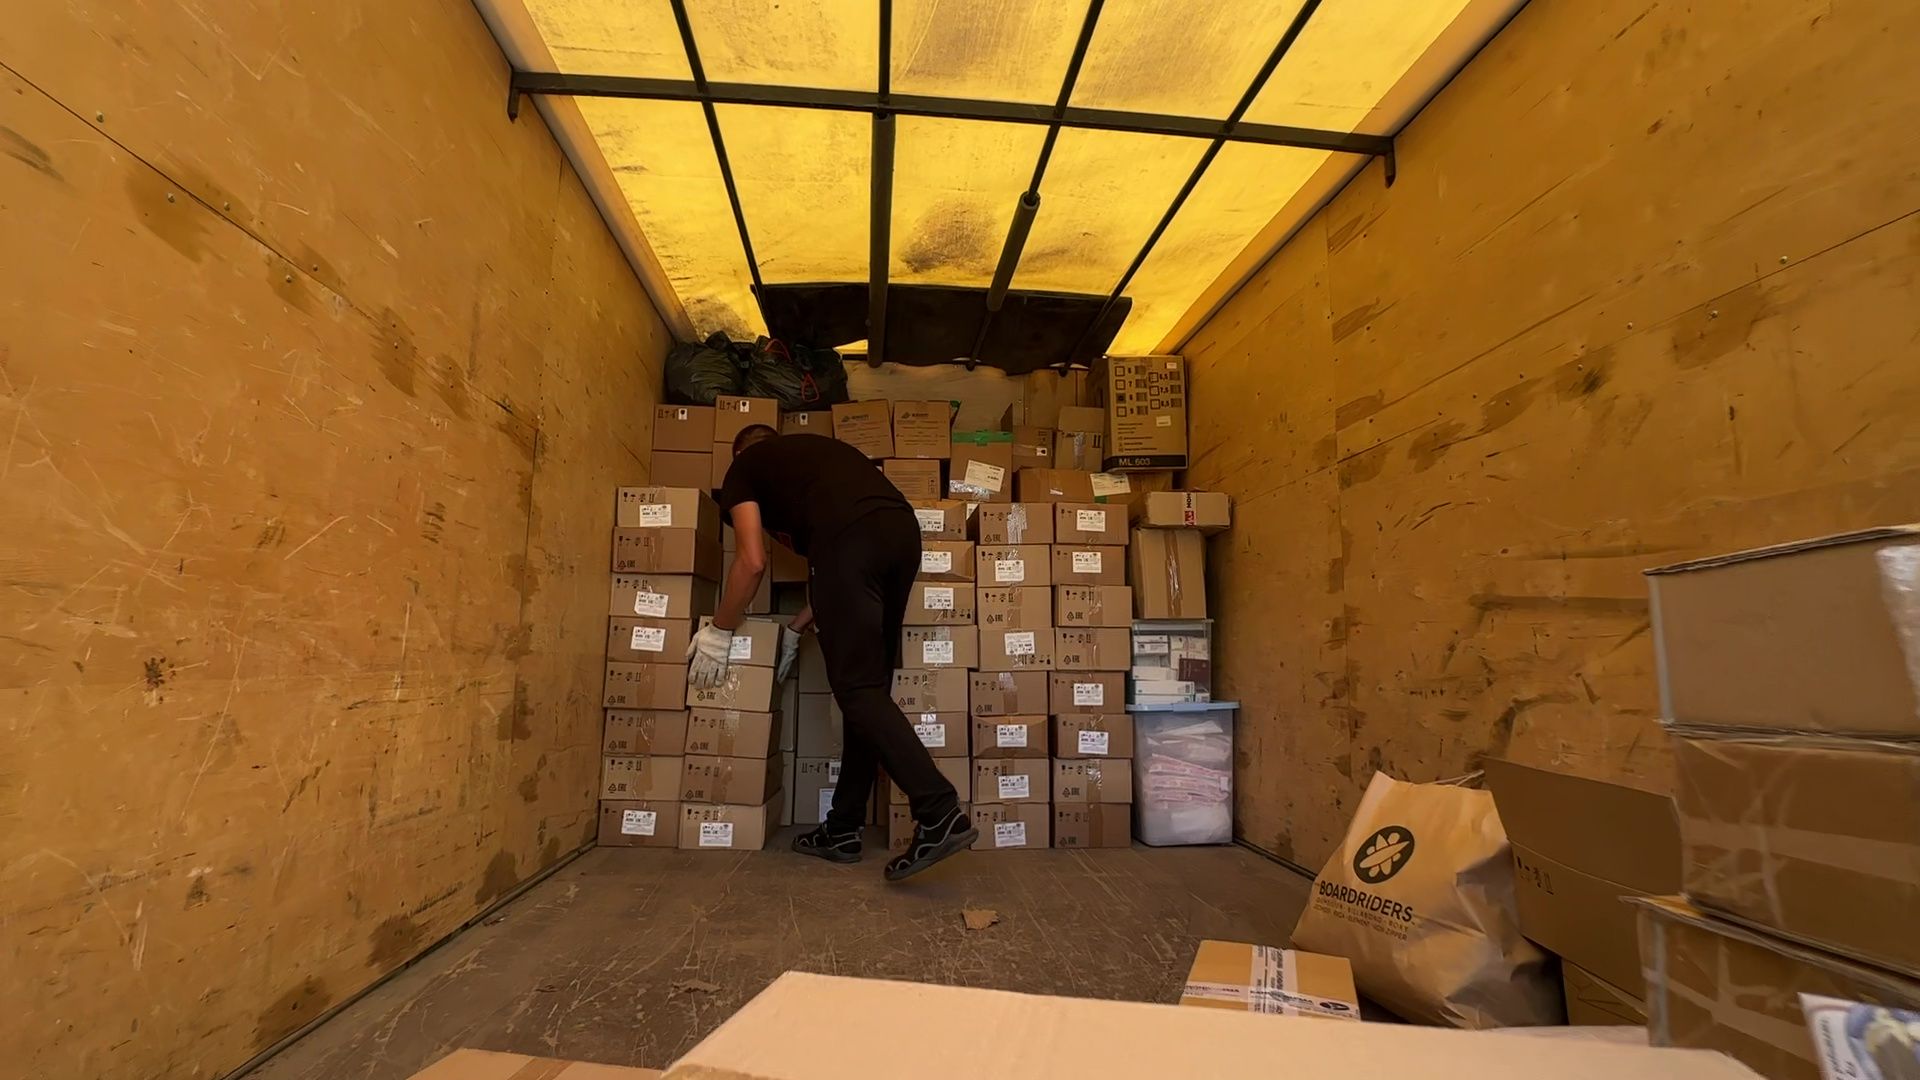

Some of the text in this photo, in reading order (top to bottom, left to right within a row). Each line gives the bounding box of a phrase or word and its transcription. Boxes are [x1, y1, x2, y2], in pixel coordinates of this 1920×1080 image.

[1118, 458, 1151, 466] ML 603
[1318, 880, 1414, 923] BOARDRIDERS
